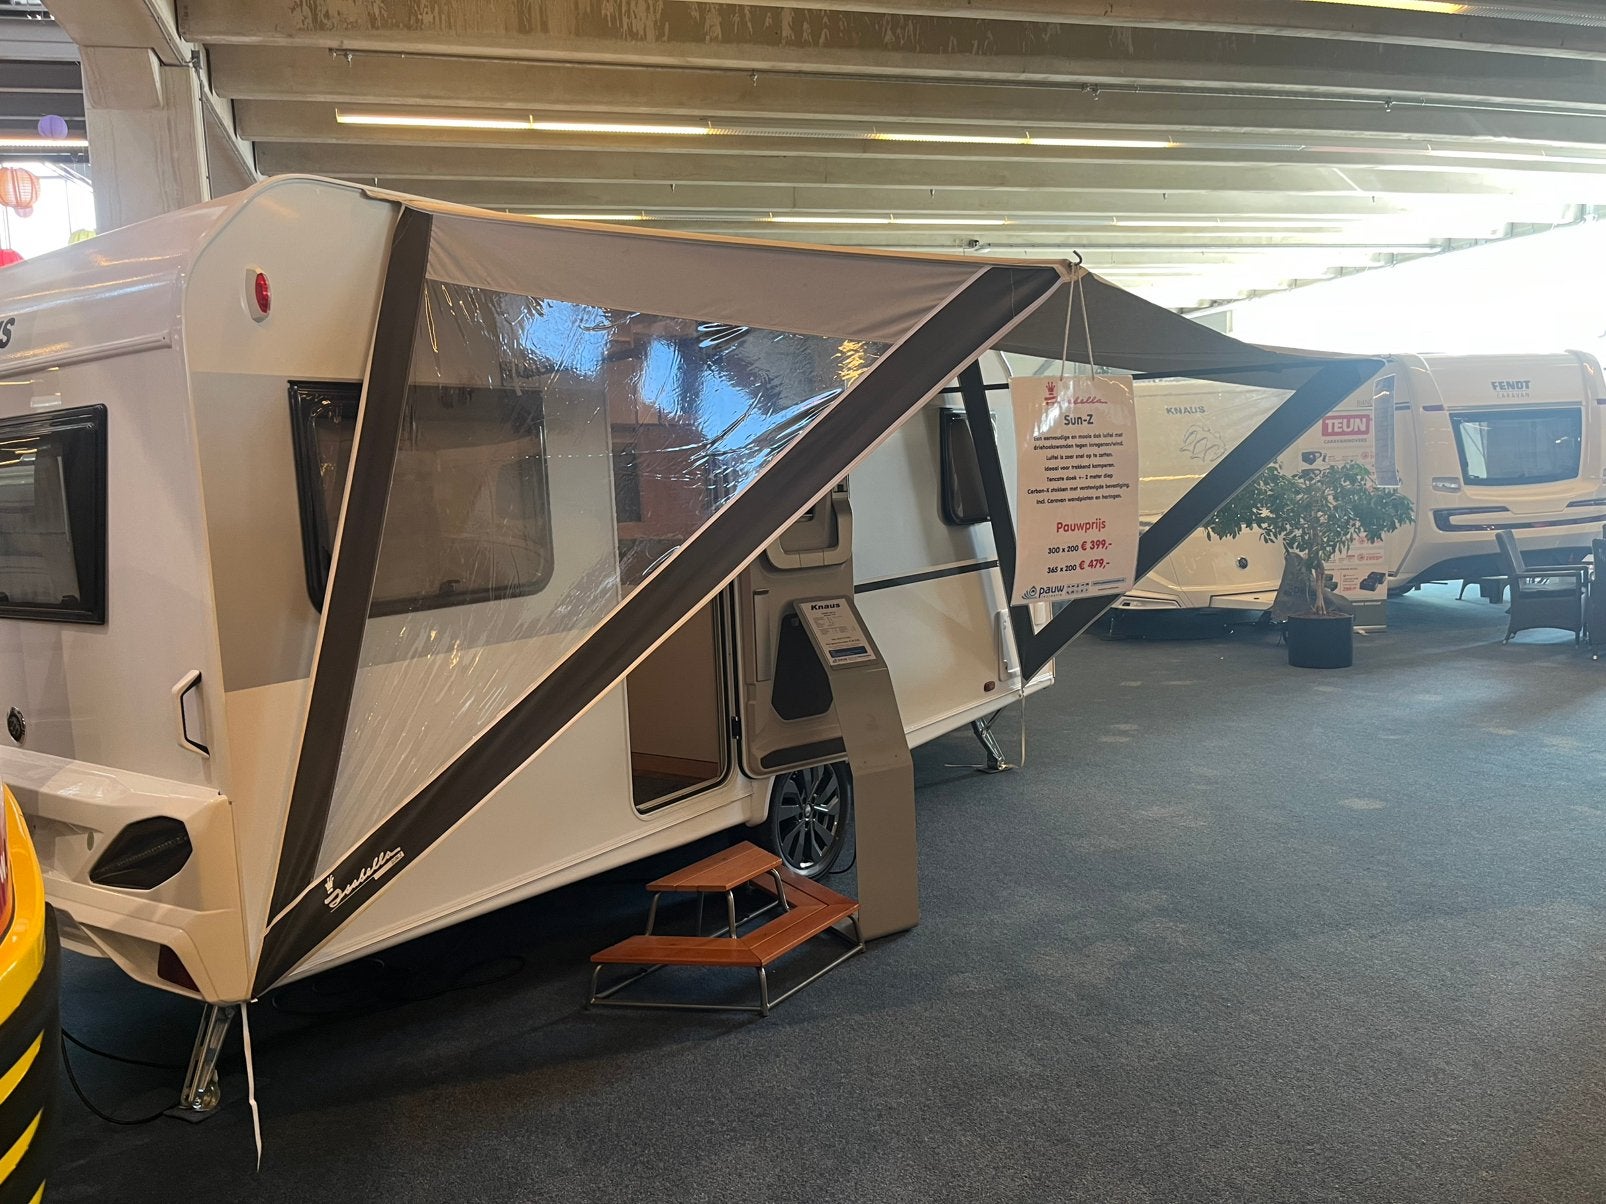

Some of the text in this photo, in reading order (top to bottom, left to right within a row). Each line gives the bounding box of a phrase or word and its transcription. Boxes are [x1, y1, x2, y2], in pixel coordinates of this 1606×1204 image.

[0, 317, 16, 349] S
[1491, 380, 1531, 390] FENDT
[1166, 406, 1206, 415] KNAUS
[1064, 414, 1094, 425] Sun-Z
[1325, 418, 1367, 433] TEUN
[1056, 518, 1106, 533] Pauwprijs
[1047, 546, 1060, 555] 300
[1066, 545, 1079, 553] 200
[1080, 541, 1087, 551] €
[1089, 539, 1112, 551] 399,-
[1047, 566, 1058, 574] 365
[1064, 564, 1077, 572] 200
[1078, 560, 1085, 570] €
[1087, 558, 1110, 569] 479,-
[1038, 584, 1065, 599] pauw
[810, 603, 840, 611] Knaus
[324, 847, 401, 908] Isabella
